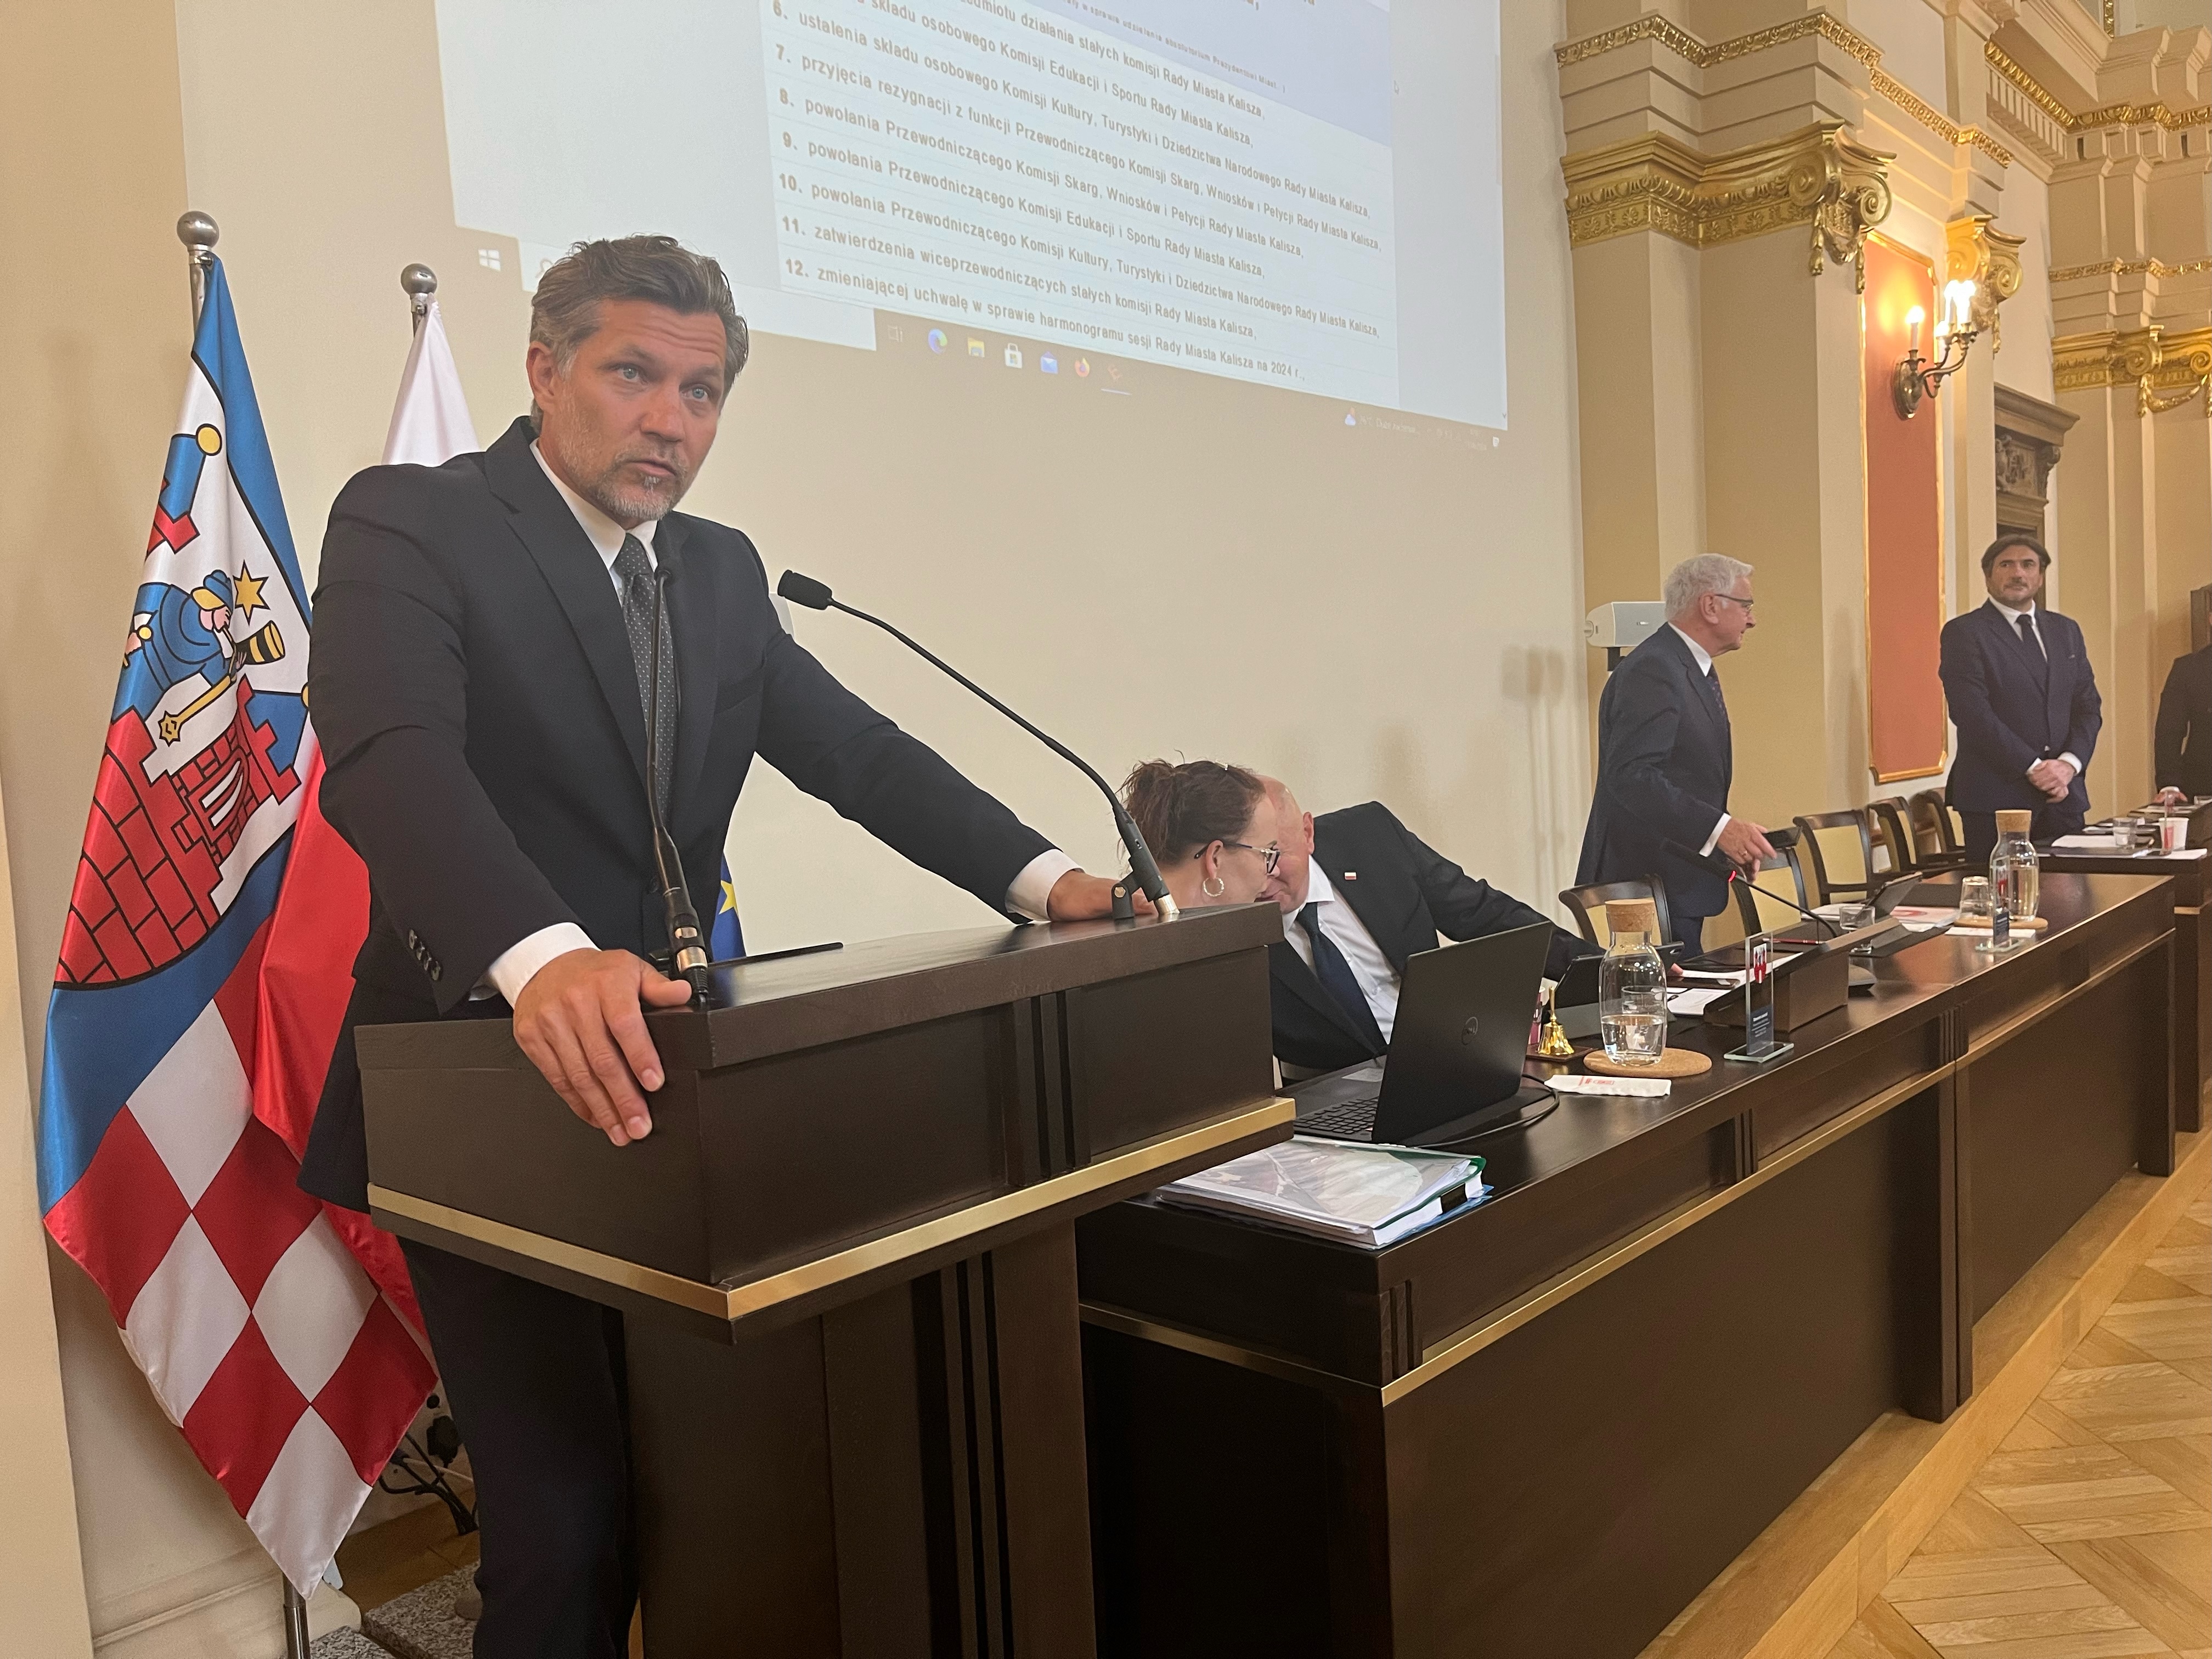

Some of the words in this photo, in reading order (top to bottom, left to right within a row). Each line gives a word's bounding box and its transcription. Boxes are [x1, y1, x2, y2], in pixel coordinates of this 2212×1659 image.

[799, 12, 867, 46] ustalenia
[924, 56, 998, 91] osobowego
[1002, 80, 1047, 110] Komisji
[1101, 114, 1152, 143] Turystyki
[1155, 133, 1158, 146] i
[1162, 136, 1221, 167] Dziedzictwa
[1225, 157, 1281, 189] Narodowego
[1284, 178, 1306, 199] Rady
[1309, 186, 1336, 206] Miasta
[921, 15, 996, 52] osobowego
[1000, 41, 1045, 72] Komisji
[1049, 59, 1099, 92] Edukacji
[1104, 80, 1107, 93] i
[1112, 83, 1147, 108] Sportu
[1151, 97, 1177, 121] Rady
[1181, 108, 1213, 131] Miasta
[1123, 52, 1160, 79] komisji
[1163, 67, 1189, 91] Rady
[1193, 79, 1225, 103] Miasta
[776, 43, 791, 63] 7.
[878, 80, 951, 116] rezygnacji
[956, 105, 963, 118] z
[968, 106, 1011, 135] funkcji
[1128, 158, 1166, 184] Komisji
[1206, 183, 1254, 210] Wniosków
[1257, 203, 1260, 212] i
[1263, 202, 1294, 225] Petycji
[1297, 213, 1319, 233] Rady
[1321, 221, 1348, 240] Miasta
[780, 88, 794, 107] 8.
[1016, 159, 1059, 187] Komisji
[1106, 186, 1160, 215] Wniosków
[1164, 204, 1167, 217] i
[1171, 206, 1205, 230] Petycji
[1209, 217, 1233, 238] Rady
[1236, 225, 1266, 246] Miasta
[782, 131, 798, 150] 9.
[1018, 196, 1062, 224] Komisji
[1066, 210, 1115, 238] Edukacji
[1119, 225, 1122, 238] i
[1127, 227, 1160, 249] Sportu
[1165, 238, 1190, 259] Rady
[1194, 246, 1225, 267] Miasta
[779, 173, 803, 193] 10.
[1020, 234, 1064, 260] Komisji
[1116, 258, 1165, 284] Turystyki
[1169, 273, 1172, 285] i
[1176, 274, 1233, 301] Dziedzictwa
[1237, 290, 1292, 316] Narodowego
[1295, 305, 1317, 323] Rady
[1319, 311, 1346, 328] Miasta
[782, 216, 805, 236] 11.
[1115, 293, 1152, 316] komisji
[1155, 303, 1181, 323] Rady
[1184, 309, 1216, 329] Miasta
[786, 258, 809, 278] 12.
[972, 300, 982, 312] w
[988, 303, 1035, 323] sprawie
[1040, 312, 1124, 342] harmonogramu
[1127, 334, 1152, 350] sesji
[1155, 336, 1181, 356] Rady
[1185, 342, 1216, 362] Miasta
[1220, 351, 1254, 369] Kalisza
[1257, 360, 1268, 371] na
[1271, 361, 1291, 376] 2024
